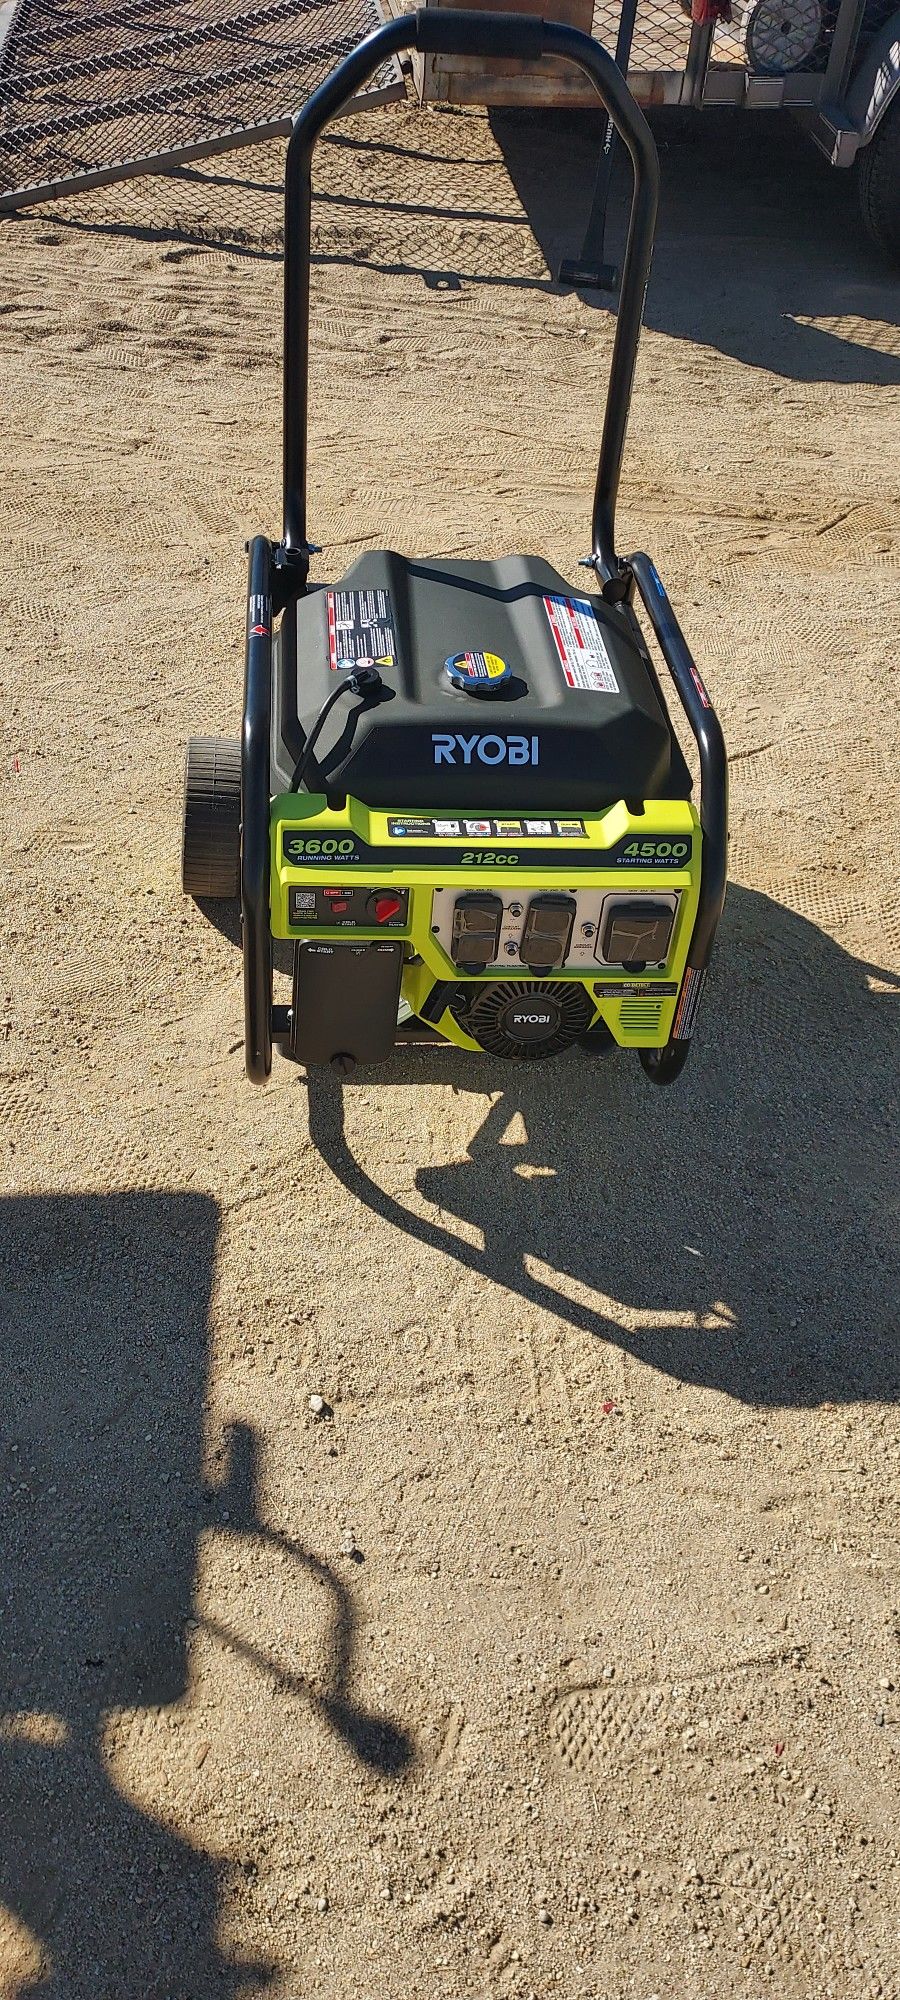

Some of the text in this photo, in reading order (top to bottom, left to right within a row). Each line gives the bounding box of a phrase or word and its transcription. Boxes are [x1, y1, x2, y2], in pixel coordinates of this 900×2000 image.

[431, 734, 539, 765] RYOBI
[288, 839, 355, 855] 3600
[623, 843, 688, 857] 4500
[461, 852, 519, 865] 212cc
[513, 1014, 550, 1024] RYOBI
